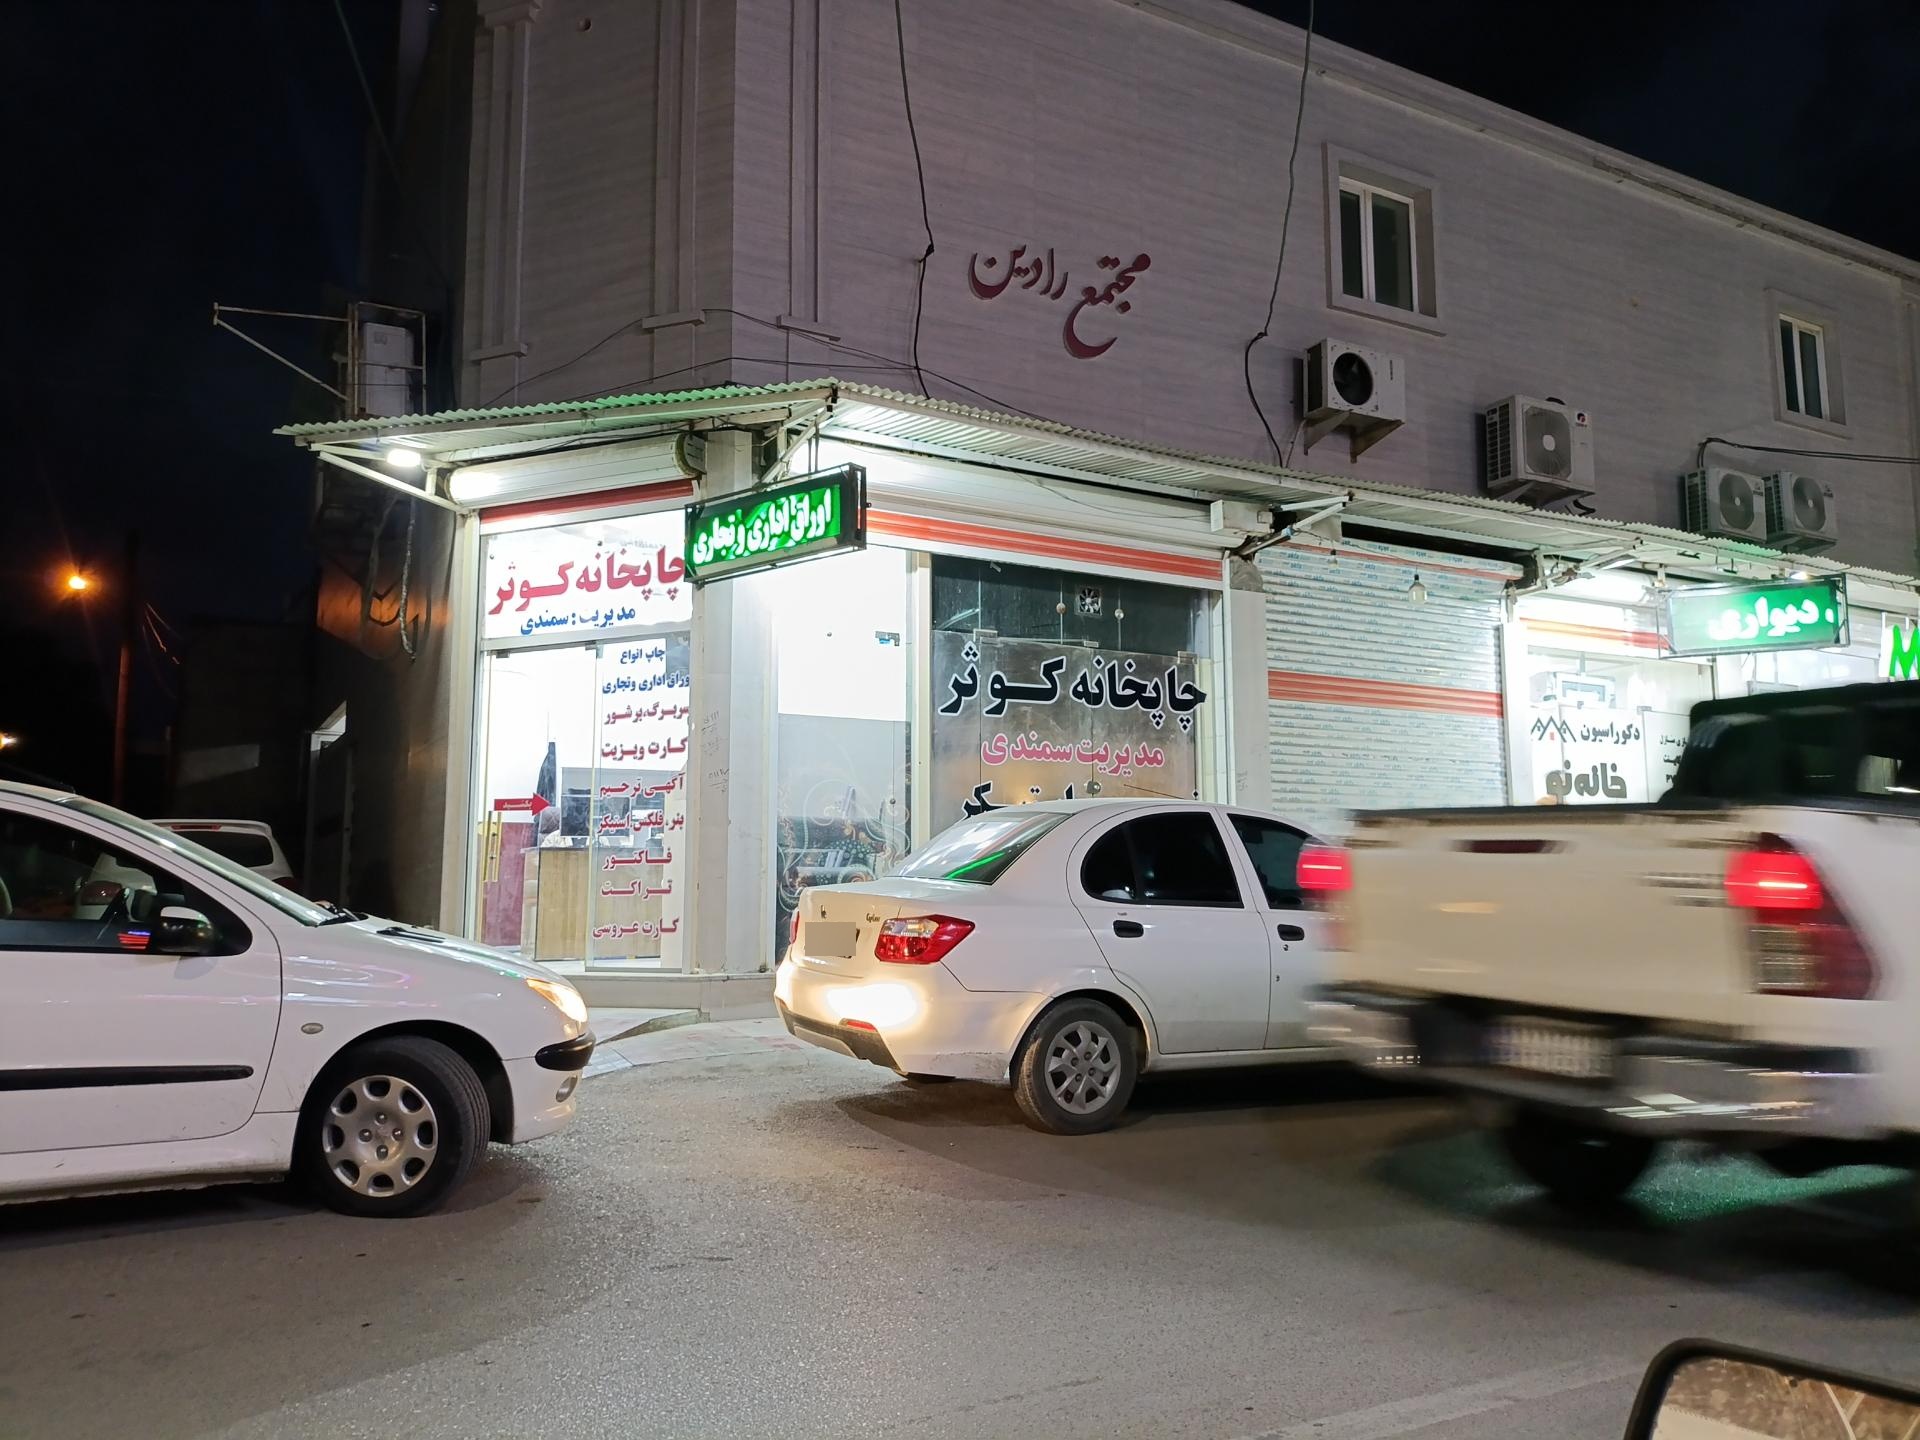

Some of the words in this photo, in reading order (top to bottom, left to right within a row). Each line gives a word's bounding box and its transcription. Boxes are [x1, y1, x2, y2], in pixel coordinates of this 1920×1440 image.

[968, 244, 1068, 300] رادین
[1062, 253, 1151, 359] مجتمع
[790, 488, 831, 541] اوراق
[574, 545, 685, 601] چاپخانه
[488, 561, 572, 615] کوثر
[520, 609, 569, 635] سمندی
[620, 648, 643, 665] انواع
[645, 646, 665, 662] چاپ
[638, 673, 665, 691] اداری
[666, 671, 690, 688] وراق
[939, 641, 1066, 716] کوثر
[1072, 656, 1207, 731] چاپخانه
[1580, 721, 1640, 745] دکوراسیون
[601, 742, 645, 761] ویزیت
[648, 737, 688, 759] کارت
[980, 731, 1073, 766] سمندی
[1075, 738, 1165, 776] مدیریت
[600, 777, 642, 798] ترحیم
[1545, 760, 1572, 800] نو
[1574, 762, 1627, 799] خانه
[603, 848, 672, 870] فاکتور
[601, 880, 673, 899] تراکت
[592, 922, 638, 938] عروسی
[641, 917, 680, 938] کارت
